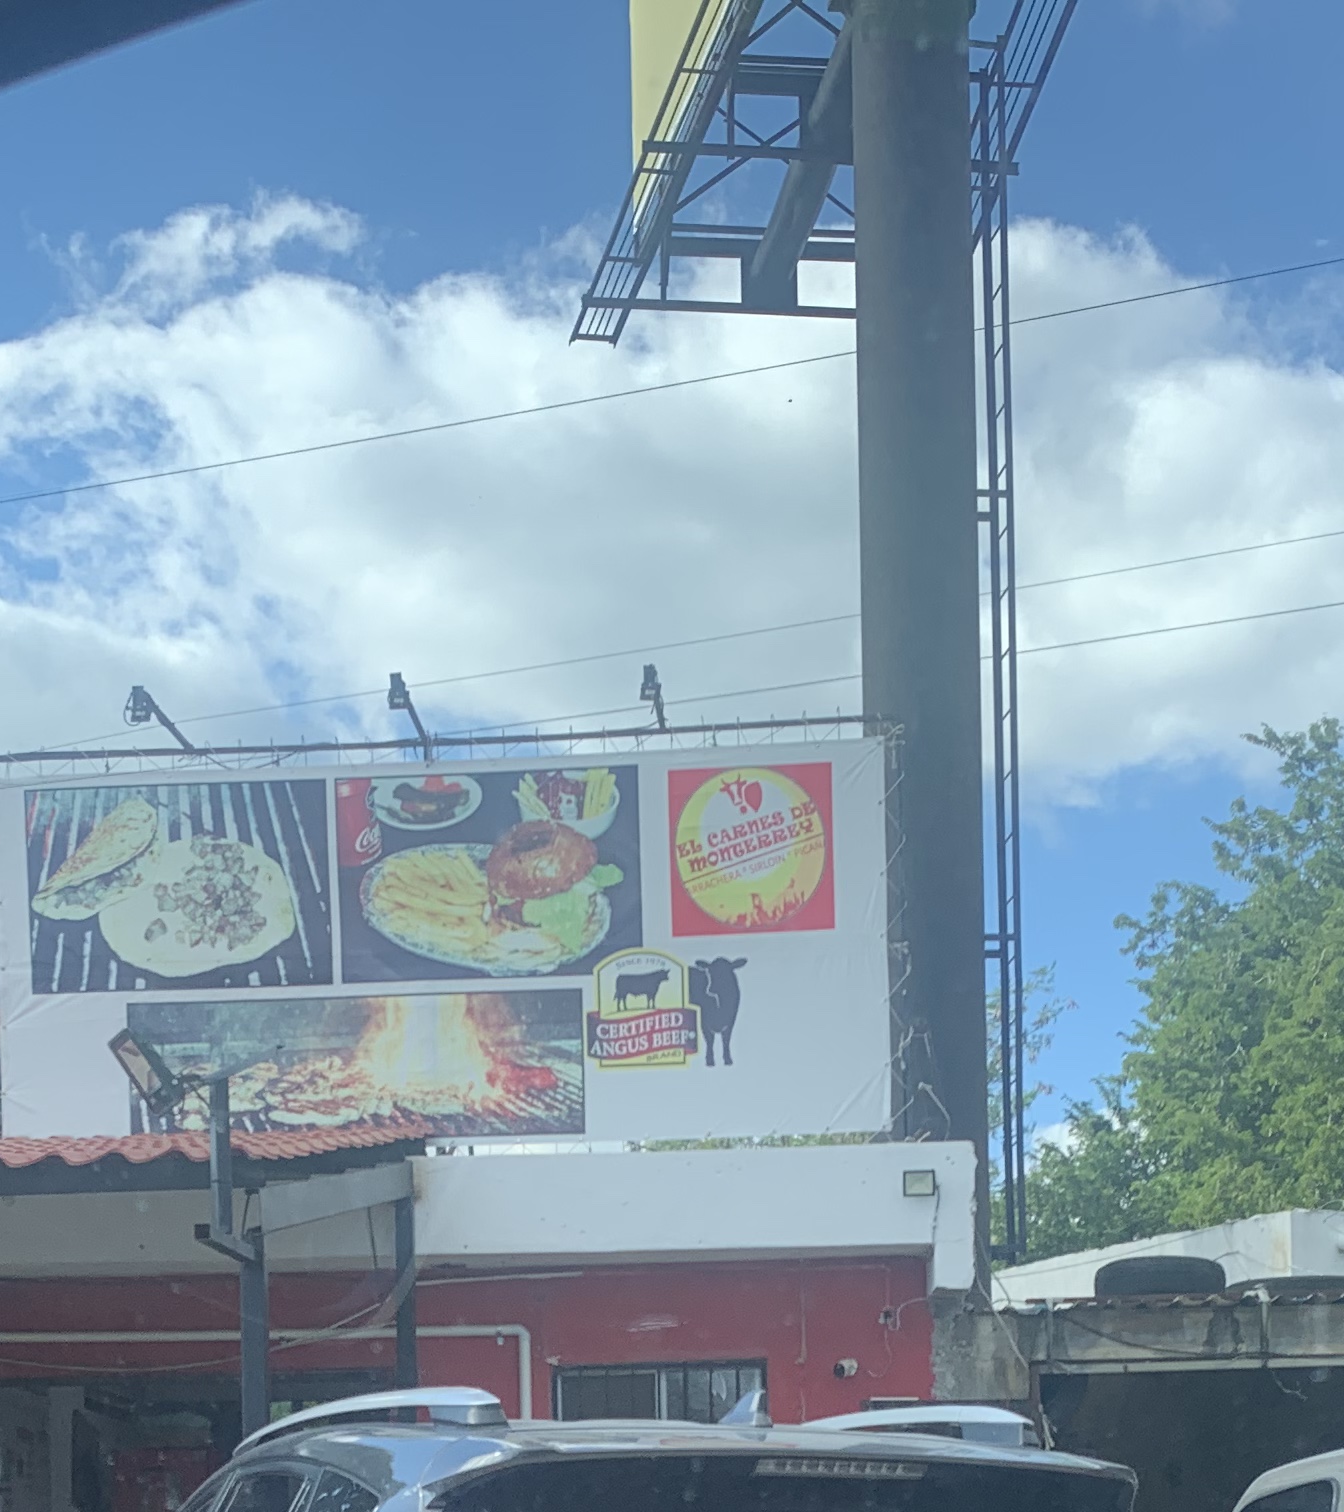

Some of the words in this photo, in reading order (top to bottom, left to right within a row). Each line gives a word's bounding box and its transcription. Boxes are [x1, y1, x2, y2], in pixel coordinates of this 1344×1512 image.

[676, 840, 703, 858] EL
[707, 811, 785, 848] CARNES
[789, 800, 817, 821] DE
[687, 818, 814, 873] MONTERREY
[689, 869, 743, 894] RRACHERA
[749, 852, 786, 874] SIRLOIN
[590, 1034, 649, 1057] ANGUS
[652, 1030, 689, 1048] BEEF
[596, 1012, 683, 1039] CERTIFIED
